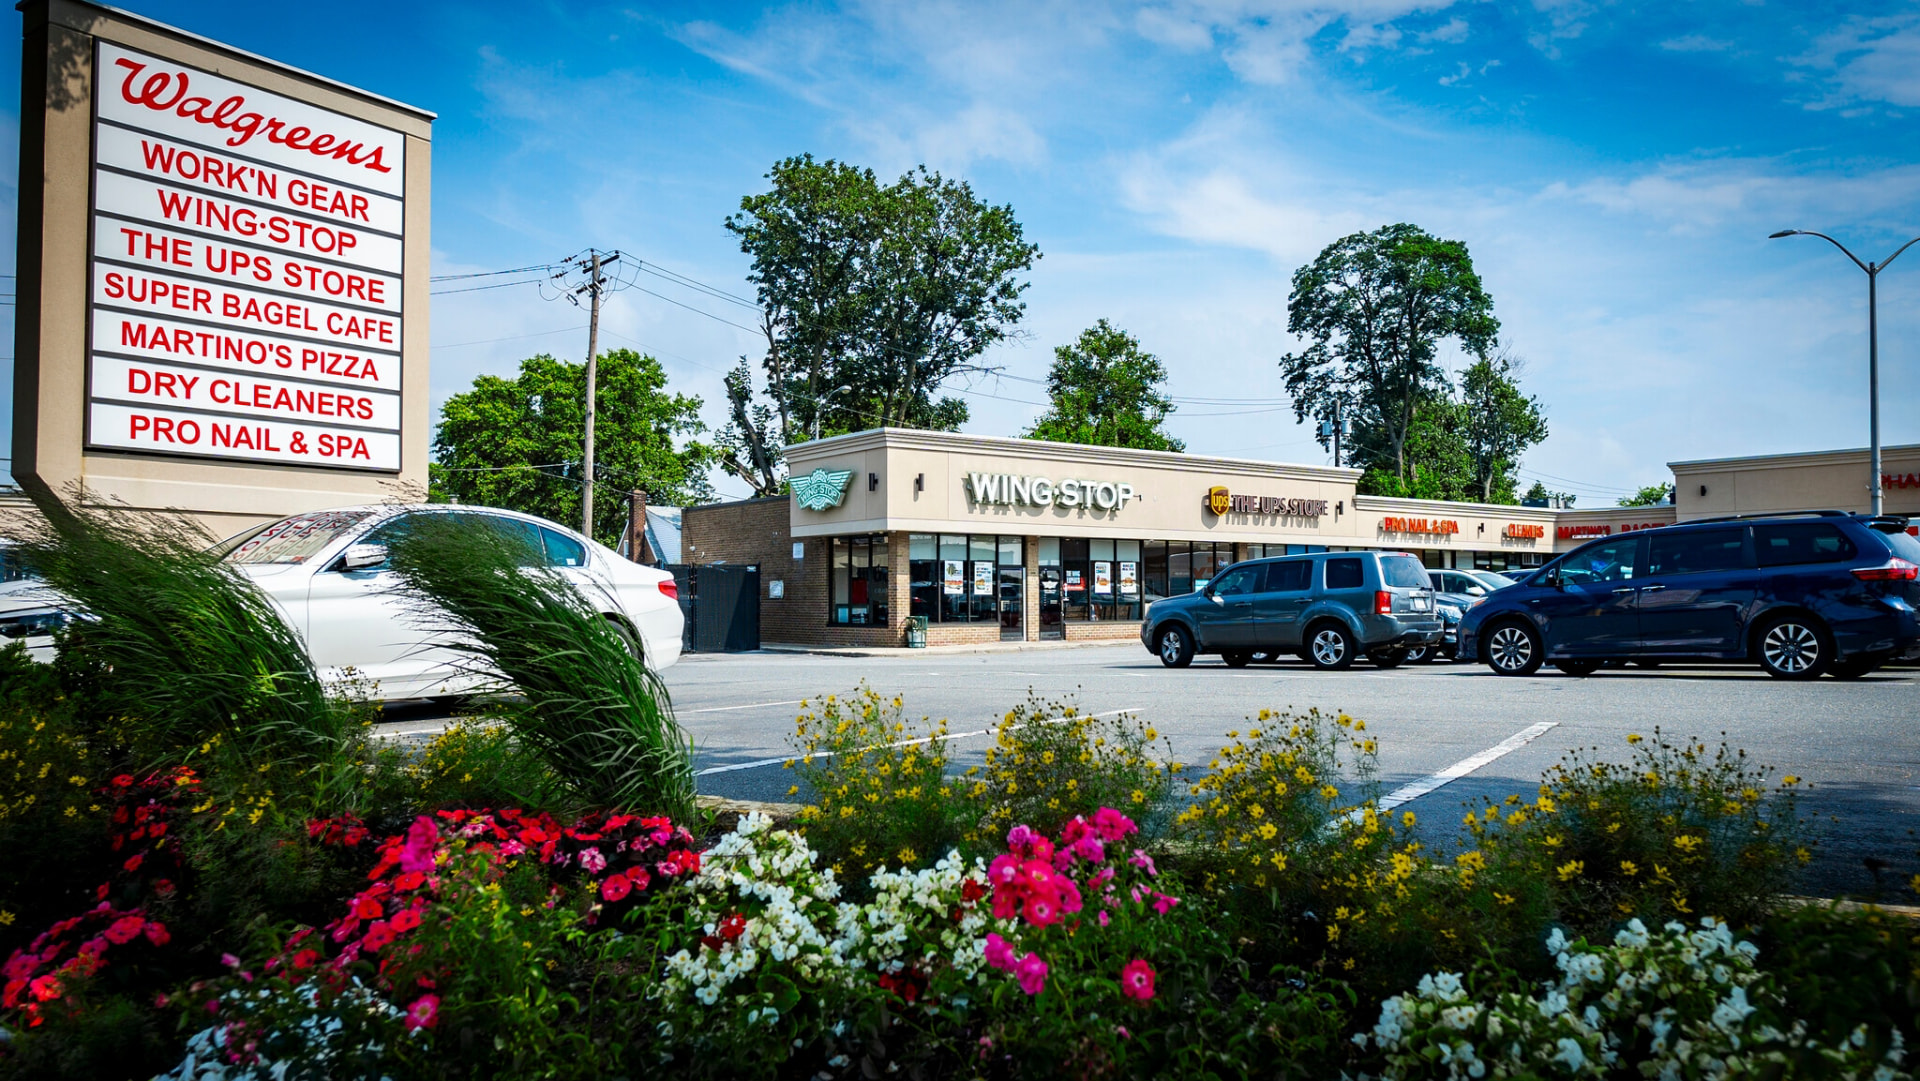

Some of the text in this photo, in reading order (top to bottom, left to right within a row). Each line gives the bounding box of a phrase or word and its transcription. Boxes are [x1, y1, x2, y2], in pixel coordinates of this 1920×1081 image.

[115, 57, 391, 174] Walgreens
[141, 139, 370, 223] WORK'N GEAR
[119, 227, 385, 304] THE UPS STORE
[104, 272, 394, 344] SUPER BAGEL CAFE
[121, 320, 379, 382] MARTINO'S PIZZA
[127, 368, 374, 421] DRY CLEANERS
[129, 414, 371, 460] PRO NAIL & SPA
[1233, 494, 1329, 516] THE UPS STORE
[1384, 516, 1460, 535] PRO NAIL & SPA
